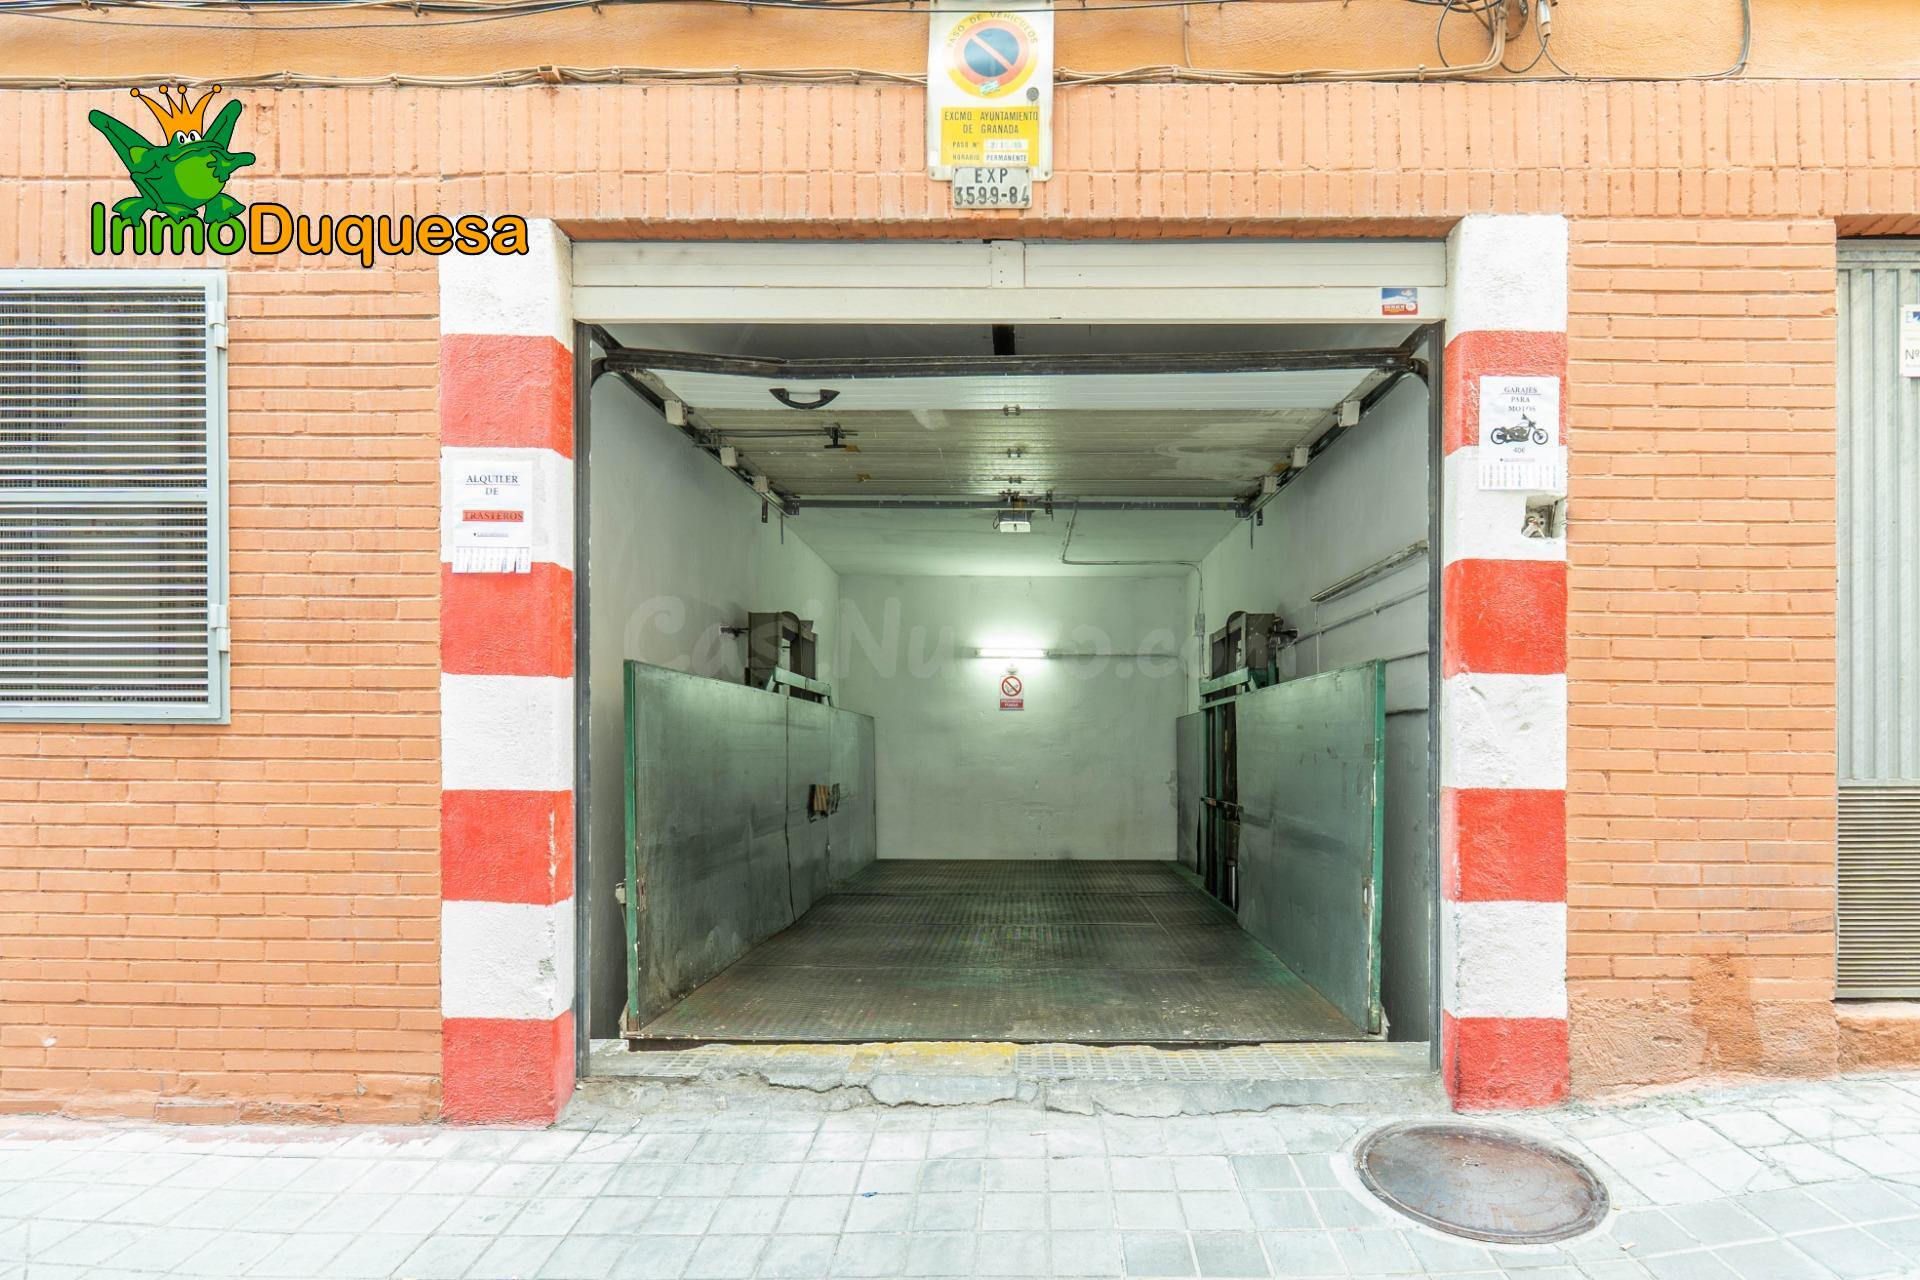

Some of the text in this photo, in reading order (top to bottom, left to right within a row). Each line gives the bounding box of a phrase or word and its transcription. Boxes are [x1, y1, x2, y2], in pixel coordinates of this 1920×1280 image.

[980, 111, 1039, 121] AYUNTAMIENTO
[962, 124, 1019, 134] DE GRANADA
[986, 154, 1027, 162] PERMANENTE
[974, 168, 1009, 184] EXP
[954, 185, 1030, 207] 3599-84
[1504, 386, 1538, 395] GARAJES
[466, 475, 519, 484] ALQUILER
[485, 487, 499, 496] DE
[463, 511, 524, 521] TRASTEROS
